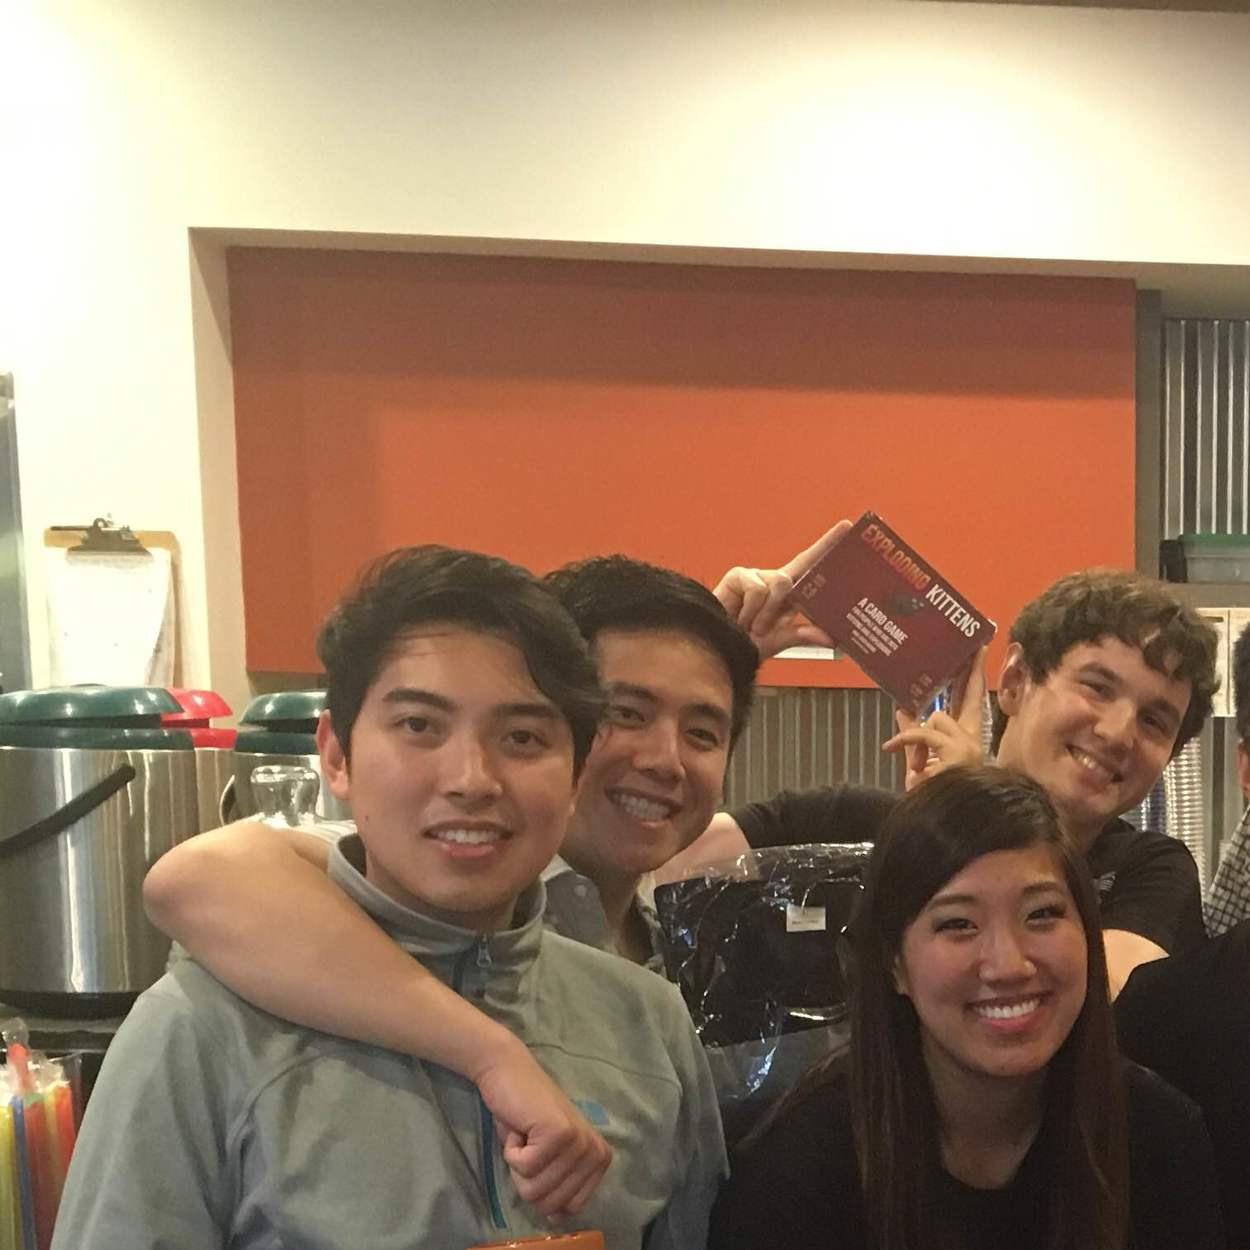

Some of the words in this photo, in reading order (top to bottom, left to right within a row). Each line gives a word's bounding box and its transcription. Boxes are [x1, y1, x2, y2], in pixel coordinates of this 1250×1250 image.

[861, 524, 932, 591] EXPLODING
[925, 583, 981, 637] KITTENS
[857, 598, 869, 609] A
[864, 602, 887, 625] CARD
[883, 620, 909, 645] GAME
